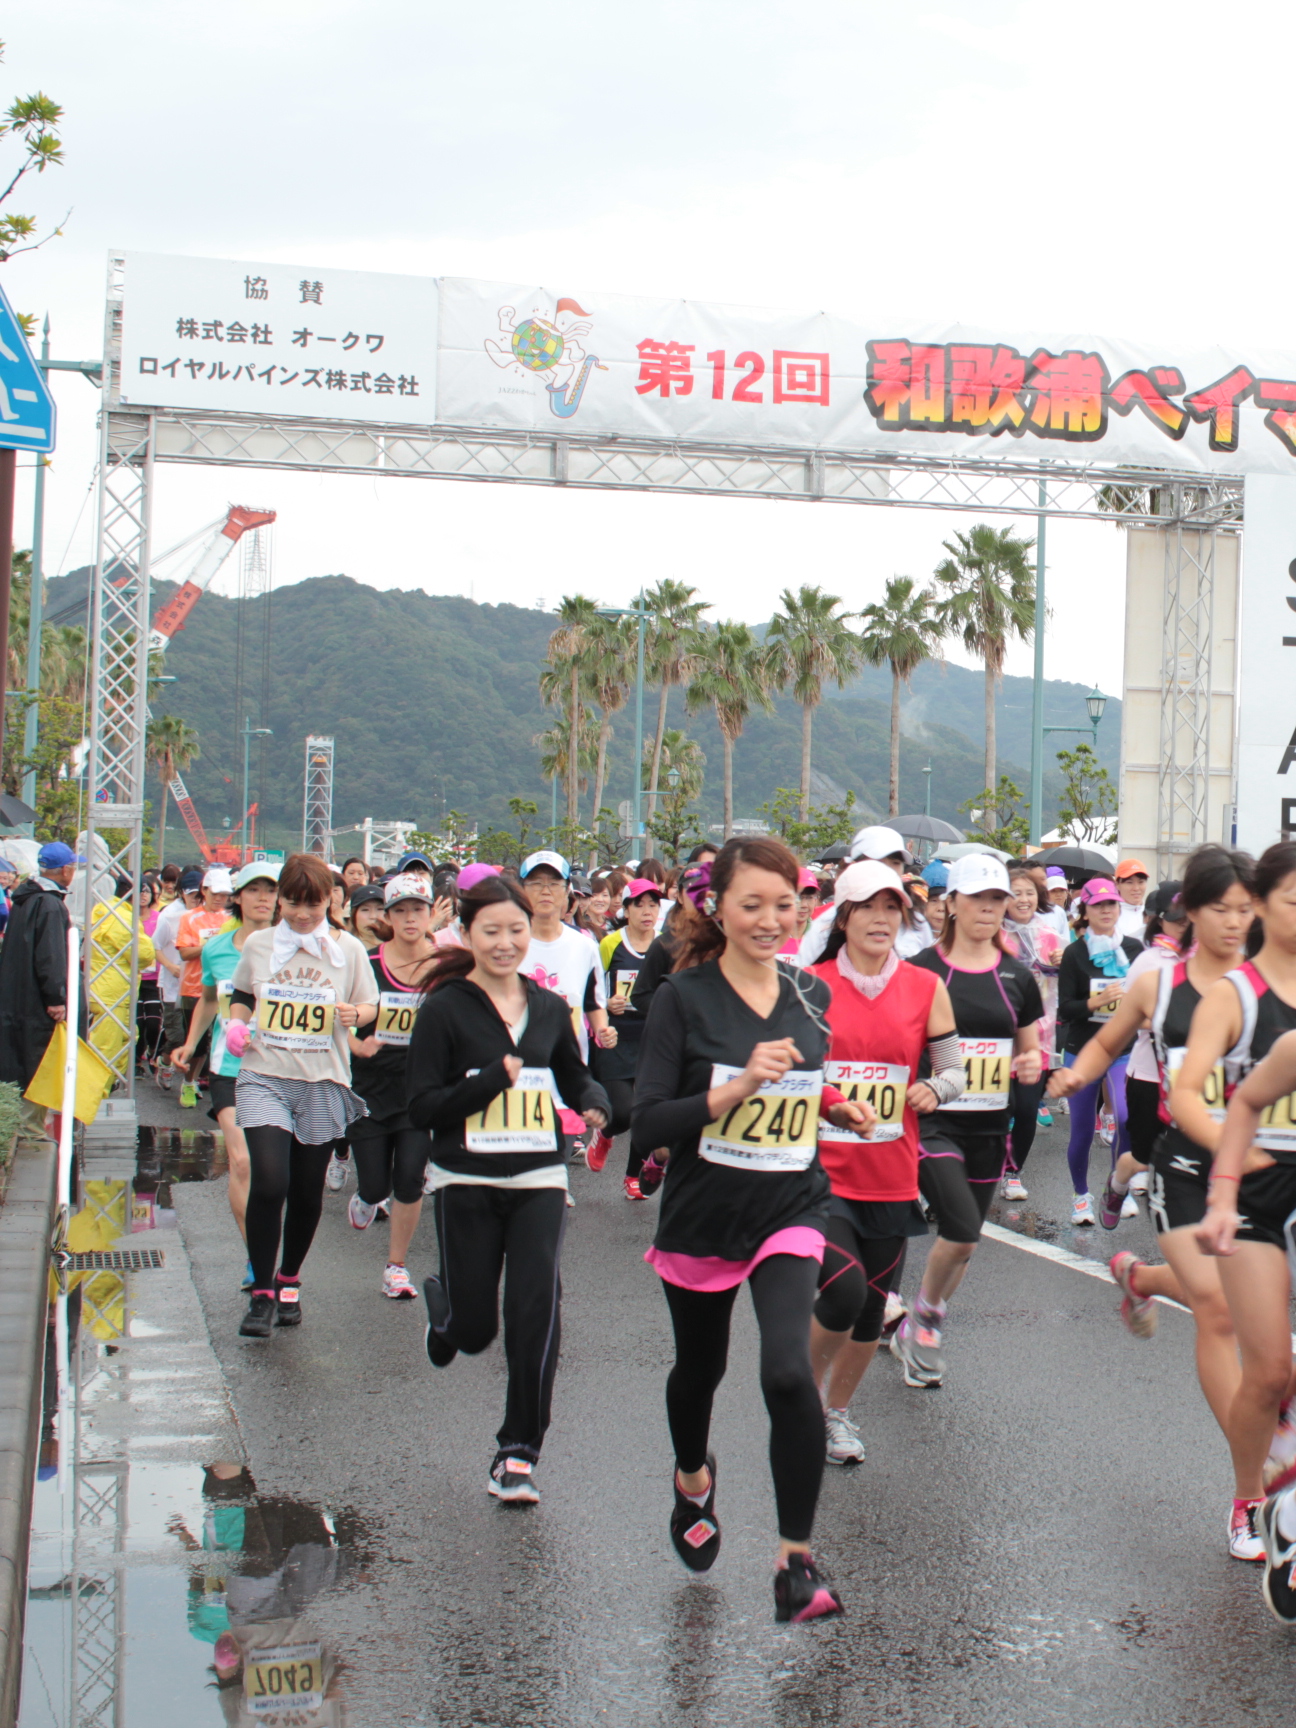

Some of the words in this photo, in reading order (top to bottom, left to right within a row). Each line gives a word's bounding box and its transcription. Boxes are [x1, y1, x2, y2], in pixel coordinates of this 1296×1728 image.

[176, 317, 273, 345] 株式会社
[291, 327, 385, 353] オークワ
[139, 356, 420, 397] ロイヤルパインズ株式会社
[635, 338, 830, 407] 第12回
[296, 967, 322, 982] AND
[267, 1001, 326, 1032] 7049
[837, 1066, 889, 1080] オークワ
